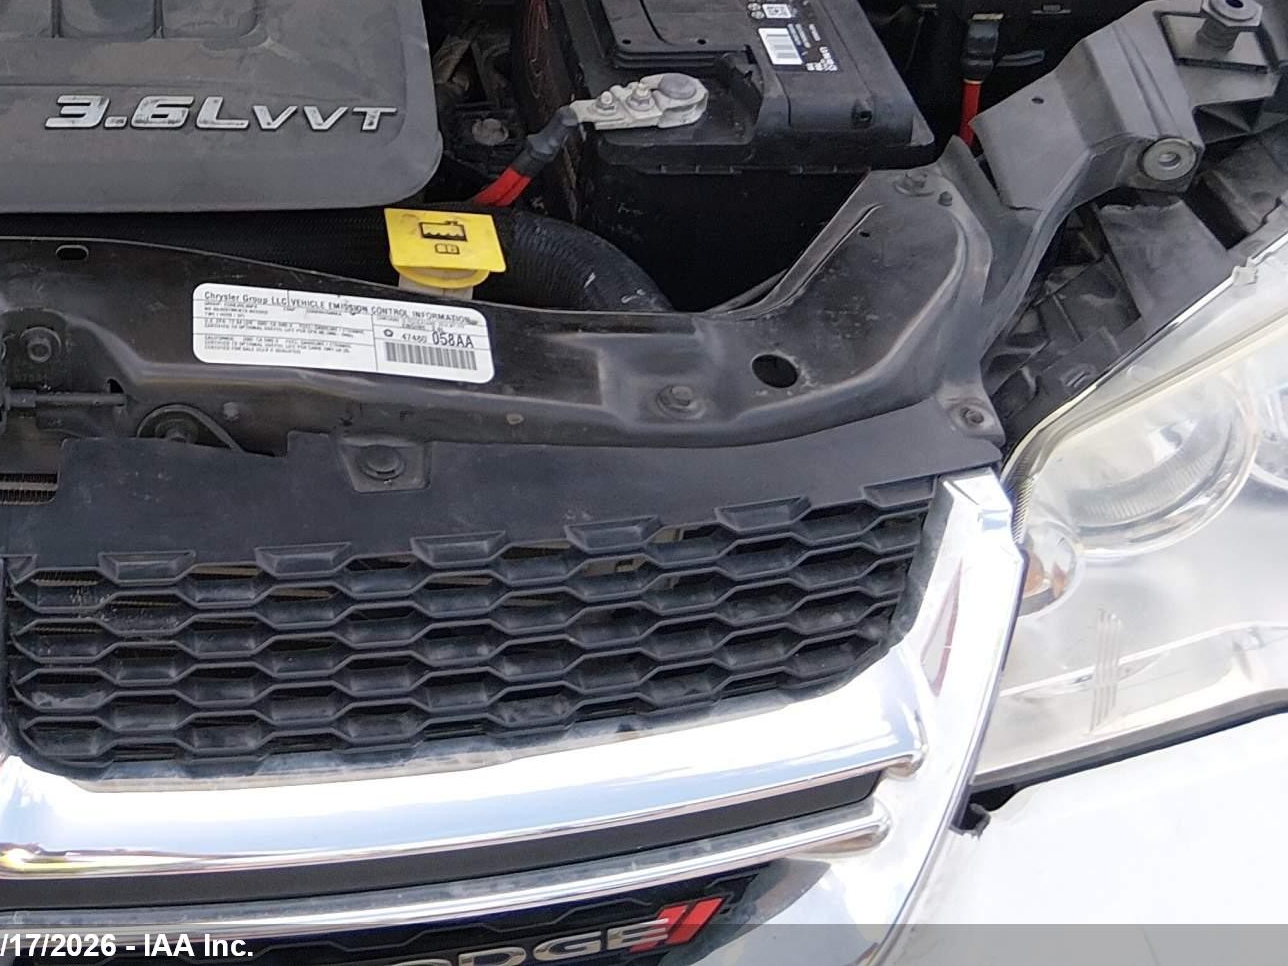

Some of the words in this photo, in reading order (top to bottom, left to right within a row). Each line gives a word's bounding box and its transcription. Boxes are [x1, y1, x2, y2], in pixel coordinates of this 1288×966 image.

[45, 95, 250, 130] 3.6L
[252, 104, 398, 131] VVT
[204, 291, 240, 304] Chrysler
[242, 294, 268, 305] Group
[271, 297, 288, 306] LLC
[291, 299, 325, 310] VEHICLE
[371, 305, 408, 318] CONTROL
[432, 331, 474, 349] 058AA
